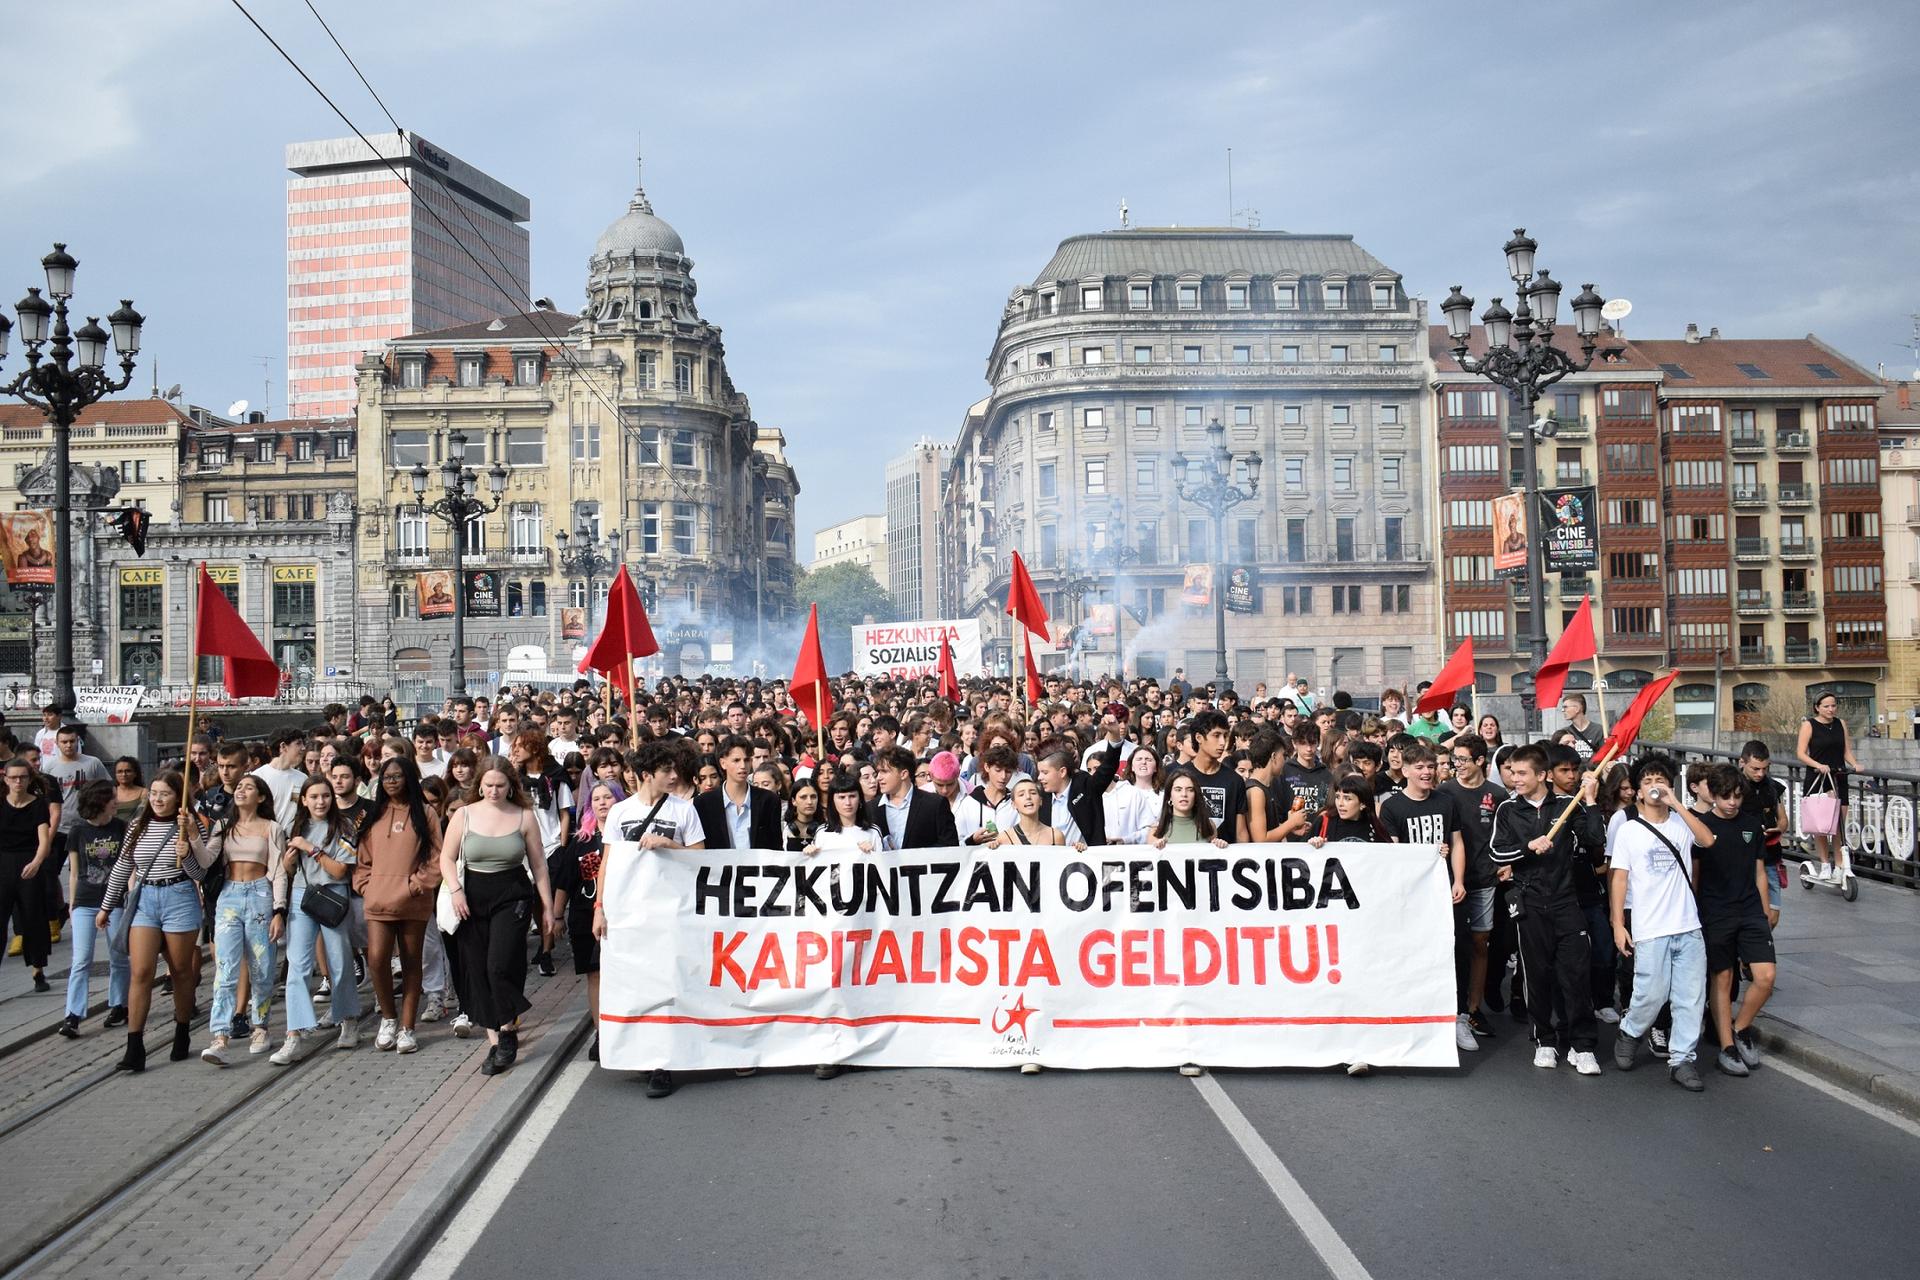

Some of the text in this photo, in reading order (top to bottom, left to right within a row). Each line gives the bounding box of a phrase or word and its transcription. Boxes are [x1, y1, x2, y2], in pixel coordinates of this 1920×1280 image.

[1557, 527, 1586, 539] CINE
[1549, 539, 1594, 550] INVISIBLE
[123, 570, 161, 582] CAFE
[198, 570, 238, 580] EVE
[275, 568, 314, 580] CAFE
[474, 591, 493, 599] CINE
[1230, 586, 1249, 595] CINE
[865, 625, 960, 646] HEZKUNTZA
[80, 687, 138, 696] HEZKUNTZA
[695, 857, 1361, 918] HEZKUNTZAN OFENTSIBA
[709, 924, 1342, 993] KAPITALISTA GELDITU!
